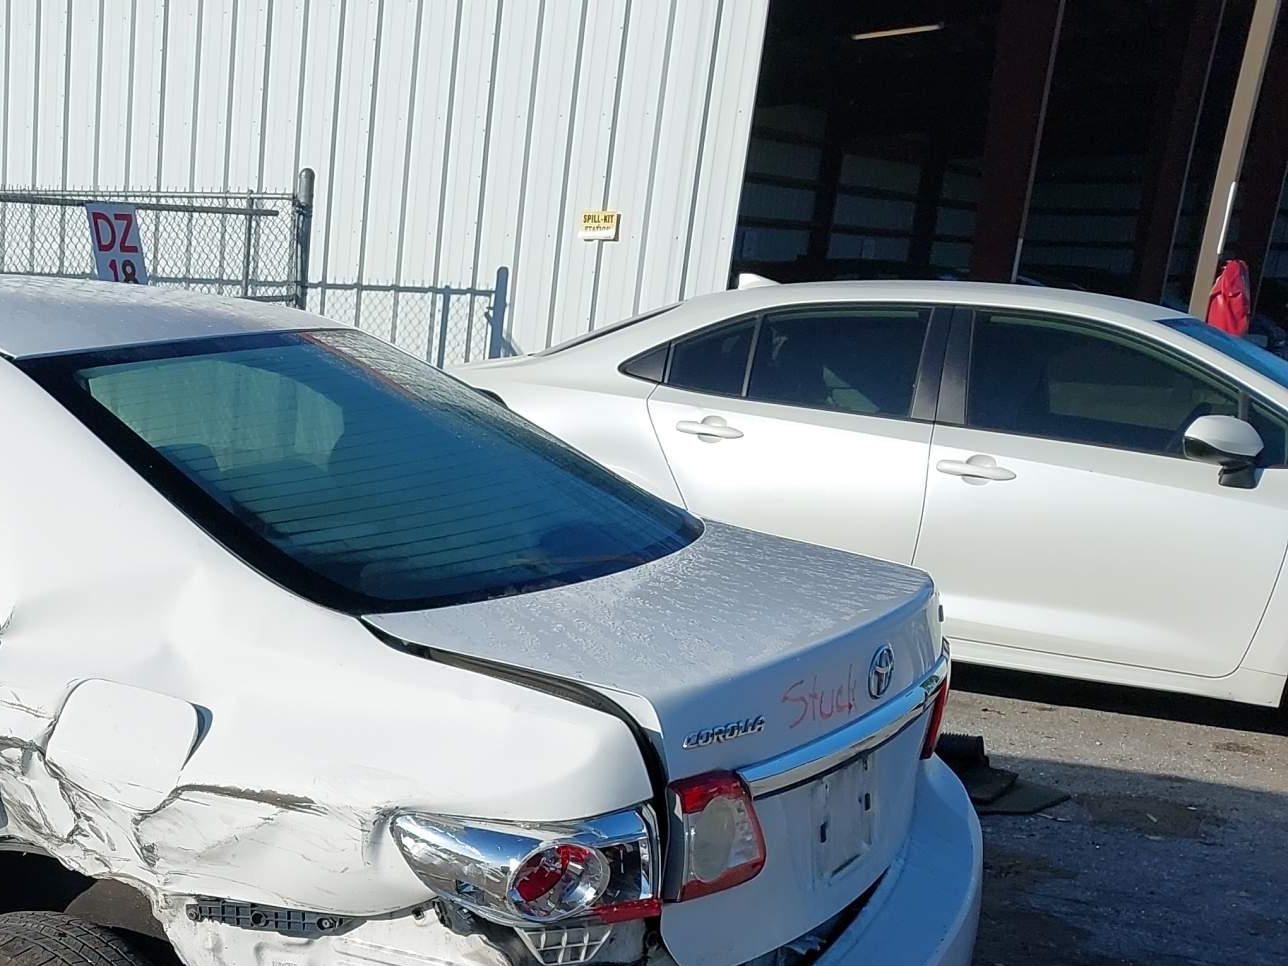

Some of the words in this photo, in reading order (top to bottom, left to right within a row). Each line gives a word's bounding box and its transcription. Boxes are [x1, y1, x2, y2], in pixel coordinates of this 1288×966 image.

[91, 211, 139, 253] DZ
[583, 214, 615, 224] SPILL-KIT
[682, 714, 767, 750] COROLLA
